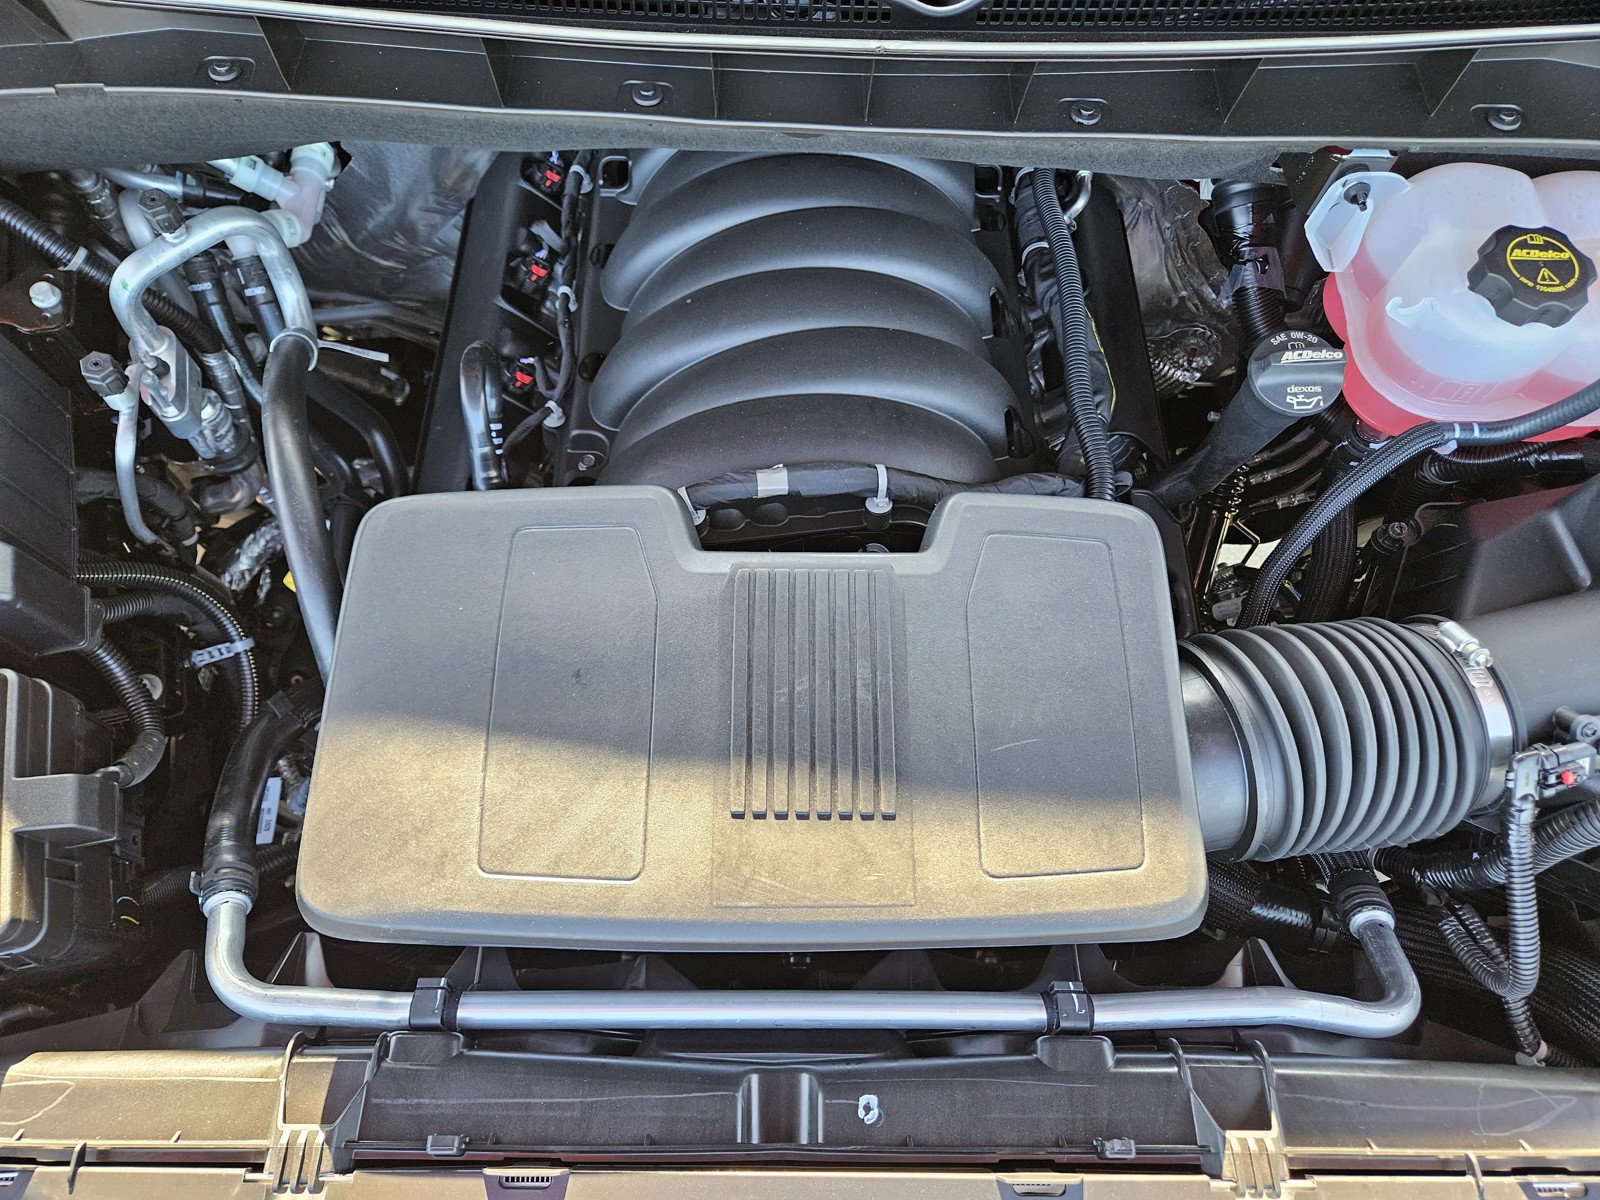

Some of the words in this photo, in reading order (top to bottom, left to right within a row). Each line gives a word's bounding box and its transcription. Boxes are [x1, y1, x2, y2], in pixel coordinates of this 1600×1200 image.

[1511, 249, 1570, 259] ACDelco
[1270, 333, 1288, 346] SAE
[1290, 331, 1319, 344] 0W-20
[1281, 349, 1343, 361] ACDelco
[1287, 385, 1322, 393] dexos
